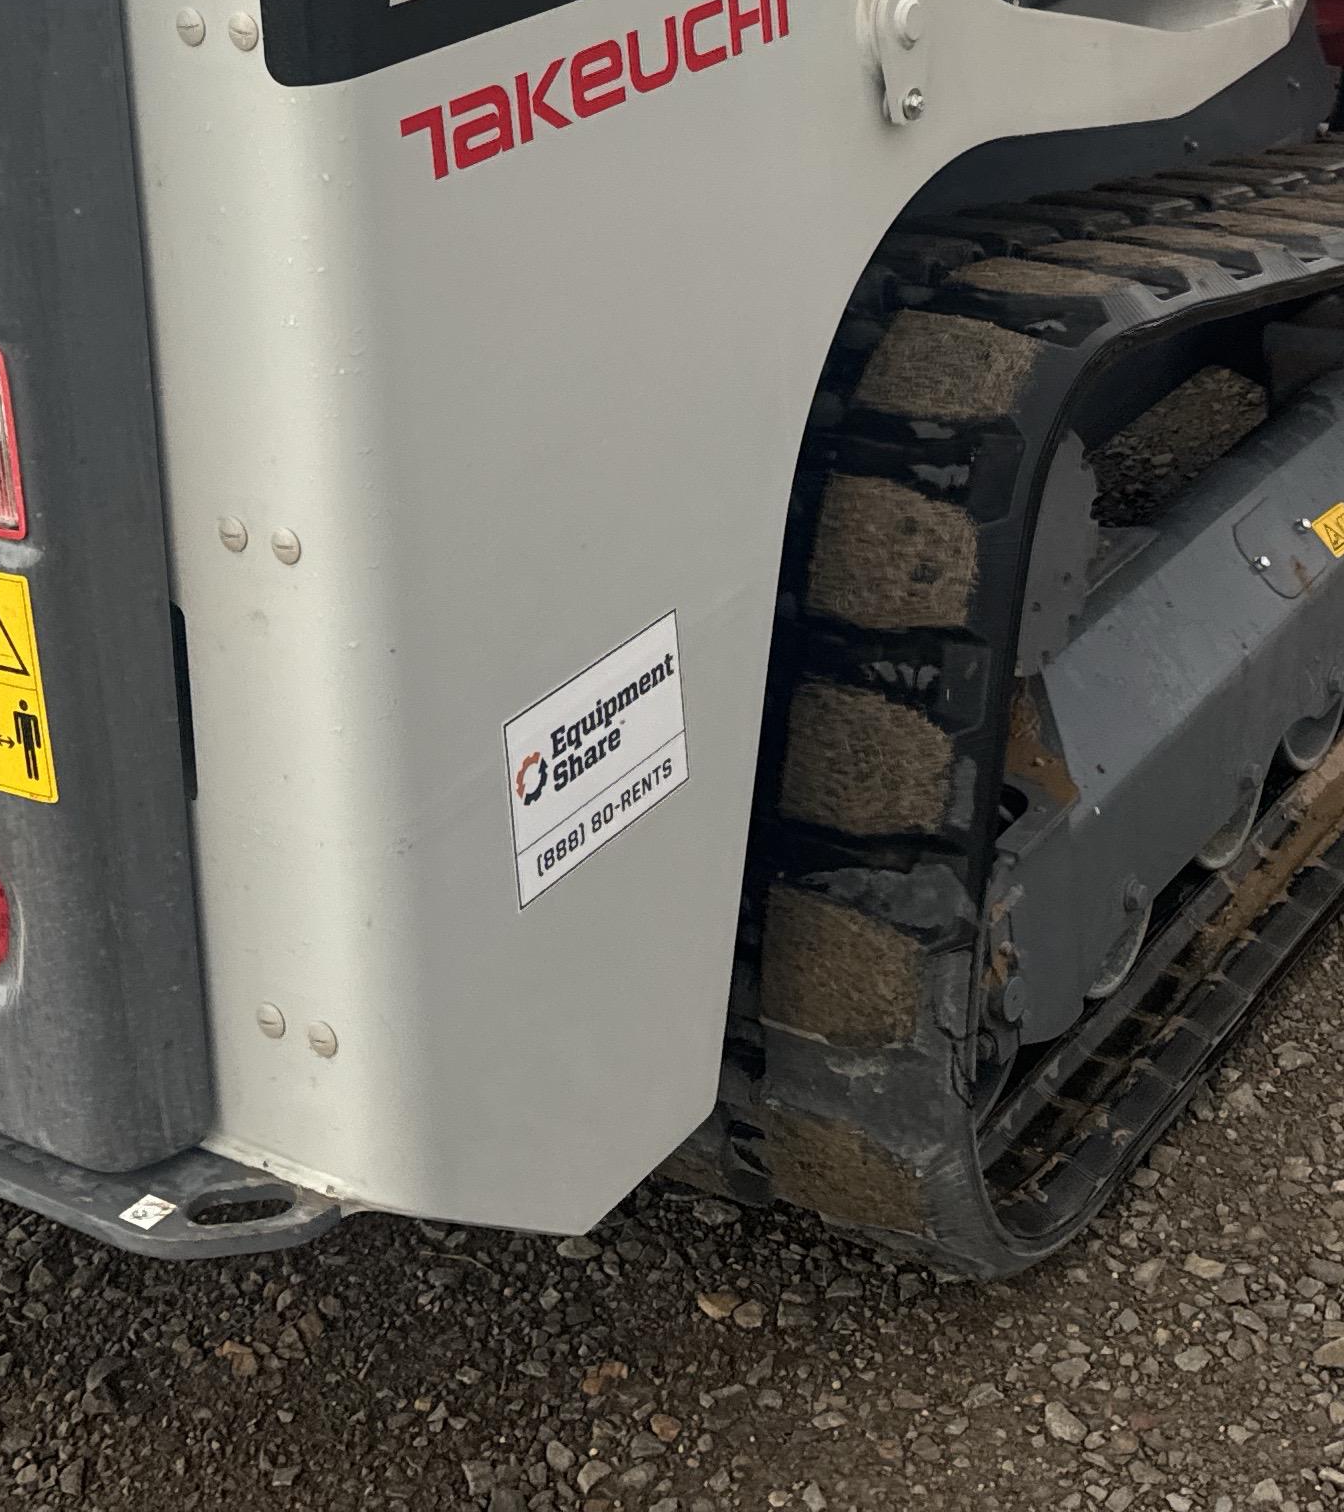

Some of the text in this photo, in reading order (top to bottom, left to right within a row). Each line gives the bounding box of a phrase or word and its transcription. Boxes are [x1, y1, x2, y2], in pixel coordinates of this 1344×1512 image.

[550, 653, 674, 759] Equipment
[553, 727, 622, 792] Share
[536, 757, 673, 877] (888) 80-RENTS
